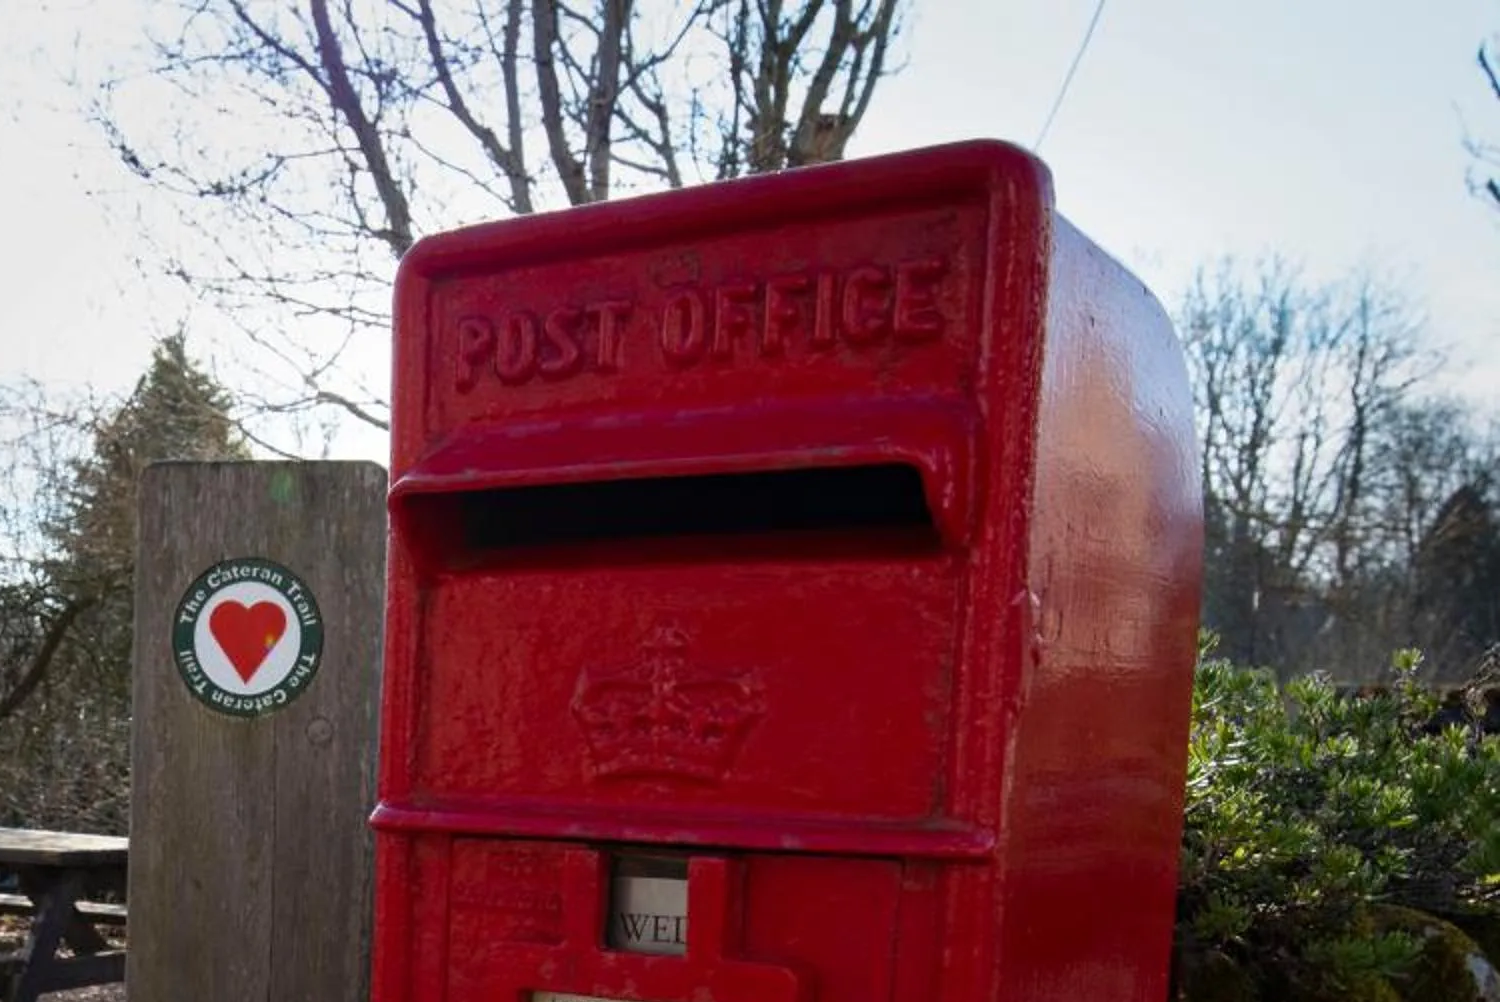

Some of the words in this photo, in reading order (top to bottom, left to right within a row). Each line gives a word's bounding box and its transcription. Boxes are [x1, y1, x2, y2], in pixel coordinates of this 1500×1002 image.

[454, 301, 631, 394] POST
[661, 260, 948, 370] OFFICE
[180, 589, 207, 625] The
[207, 566, 284, 588] Cateran
[287, 580, 317, 627] Trail
[179, 650, 208, 694] Trail
[288, 653, 317, 688] The
[211, 688, 287, 713] Cateran
